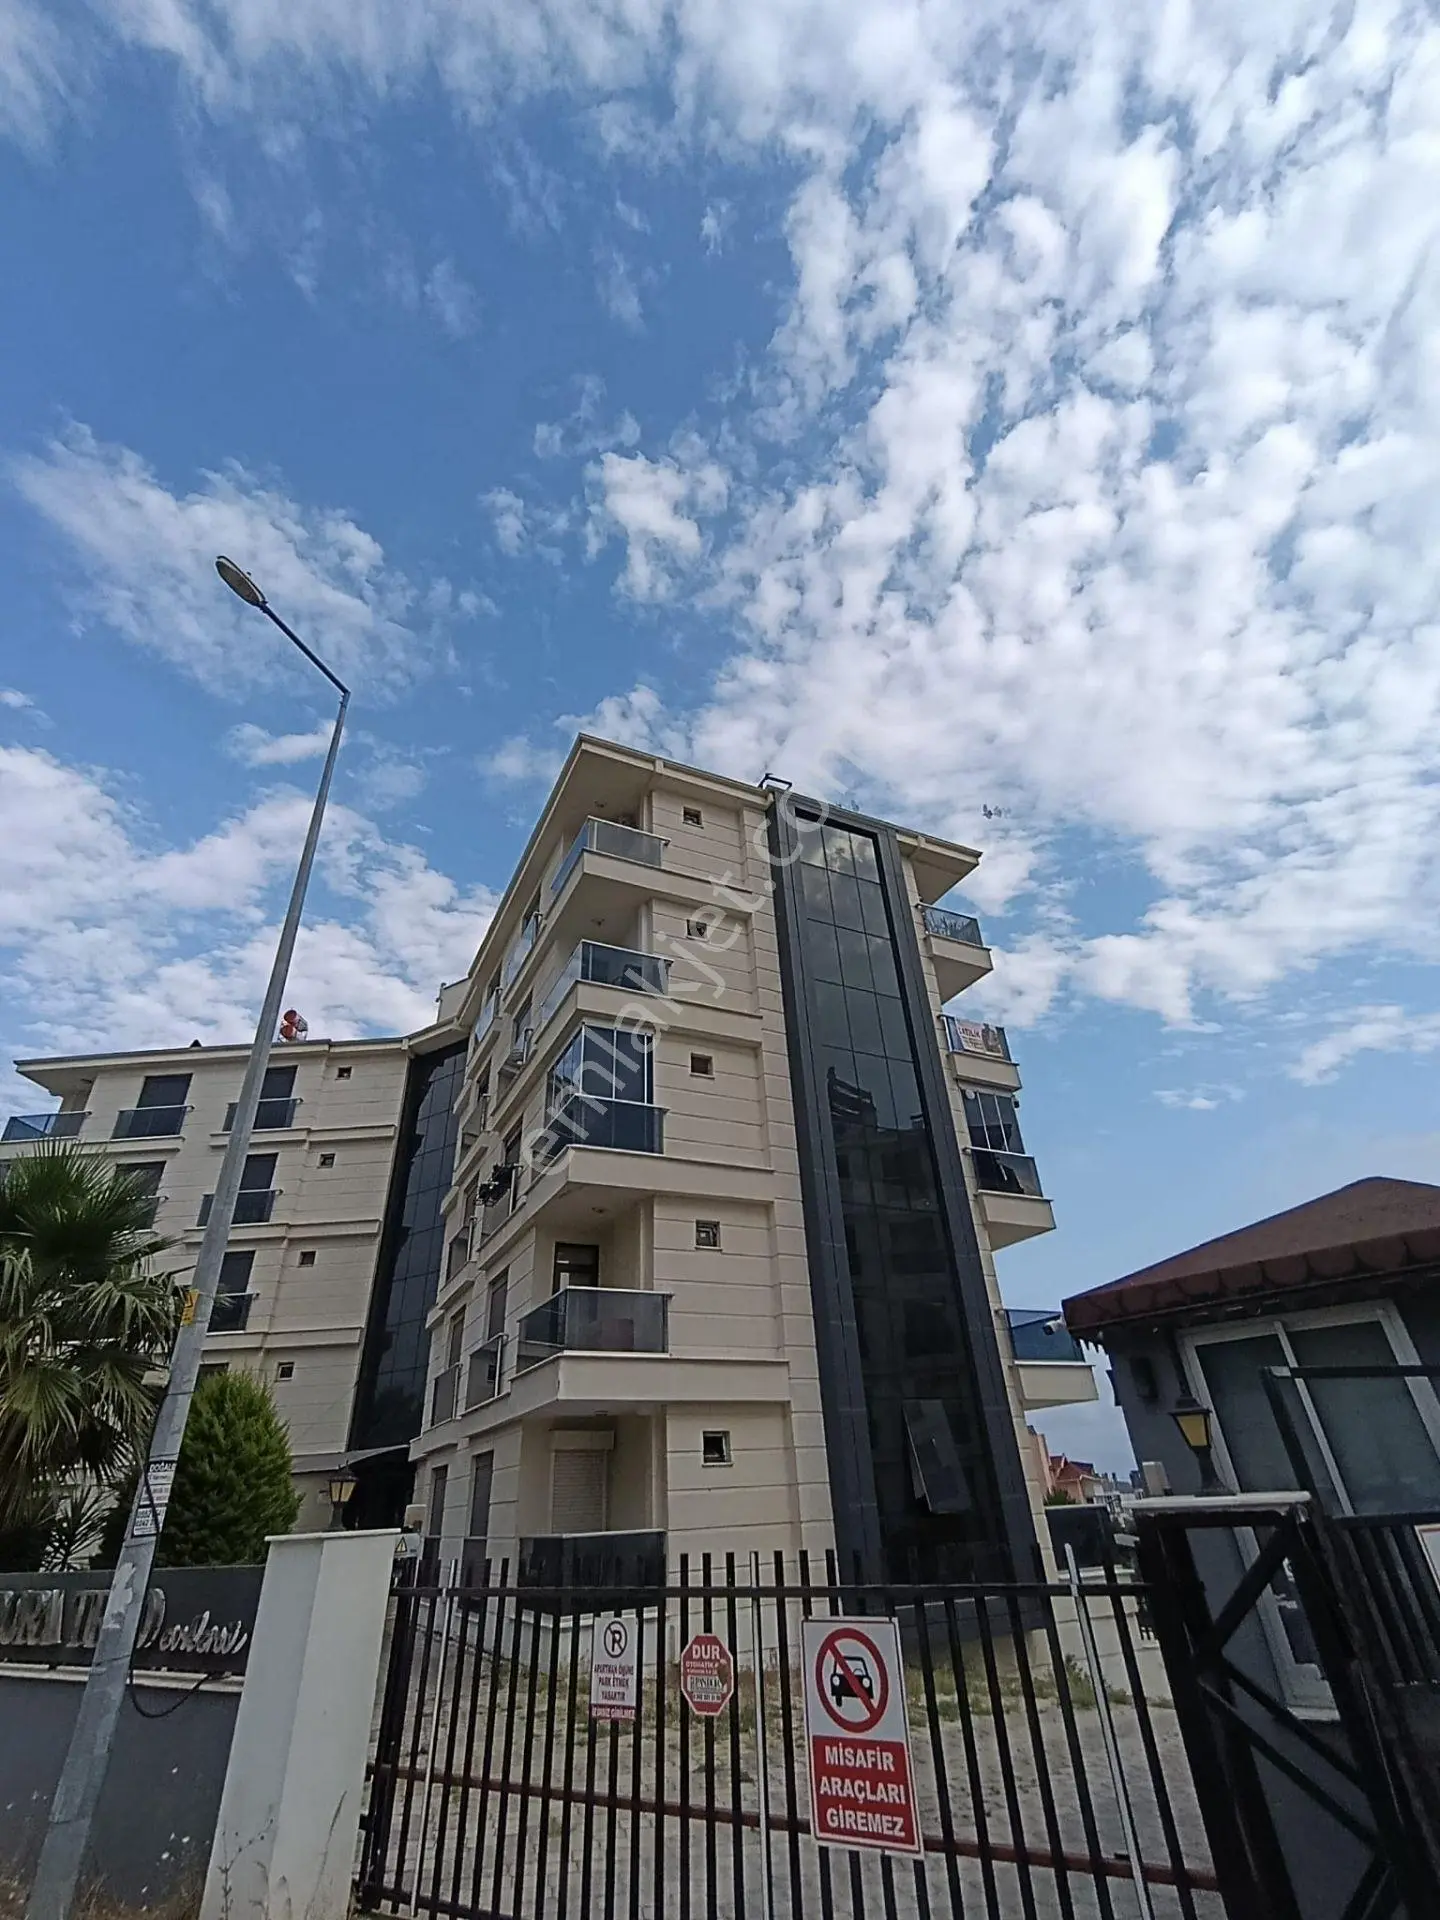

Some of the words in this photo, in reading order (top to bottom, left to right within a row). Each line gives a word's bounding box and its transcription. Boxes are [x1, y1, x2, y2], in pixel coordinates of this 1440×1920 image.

[692, 1644, 721, 1660] DUR
[598, 1676, 611, 1686] PARK
[825, 1743, 895, 1772] MİSAFİR
[820, 1775, 906, 1805] ARAÇLARI
[826, 1805, 905, 1837] GİREMEZ
